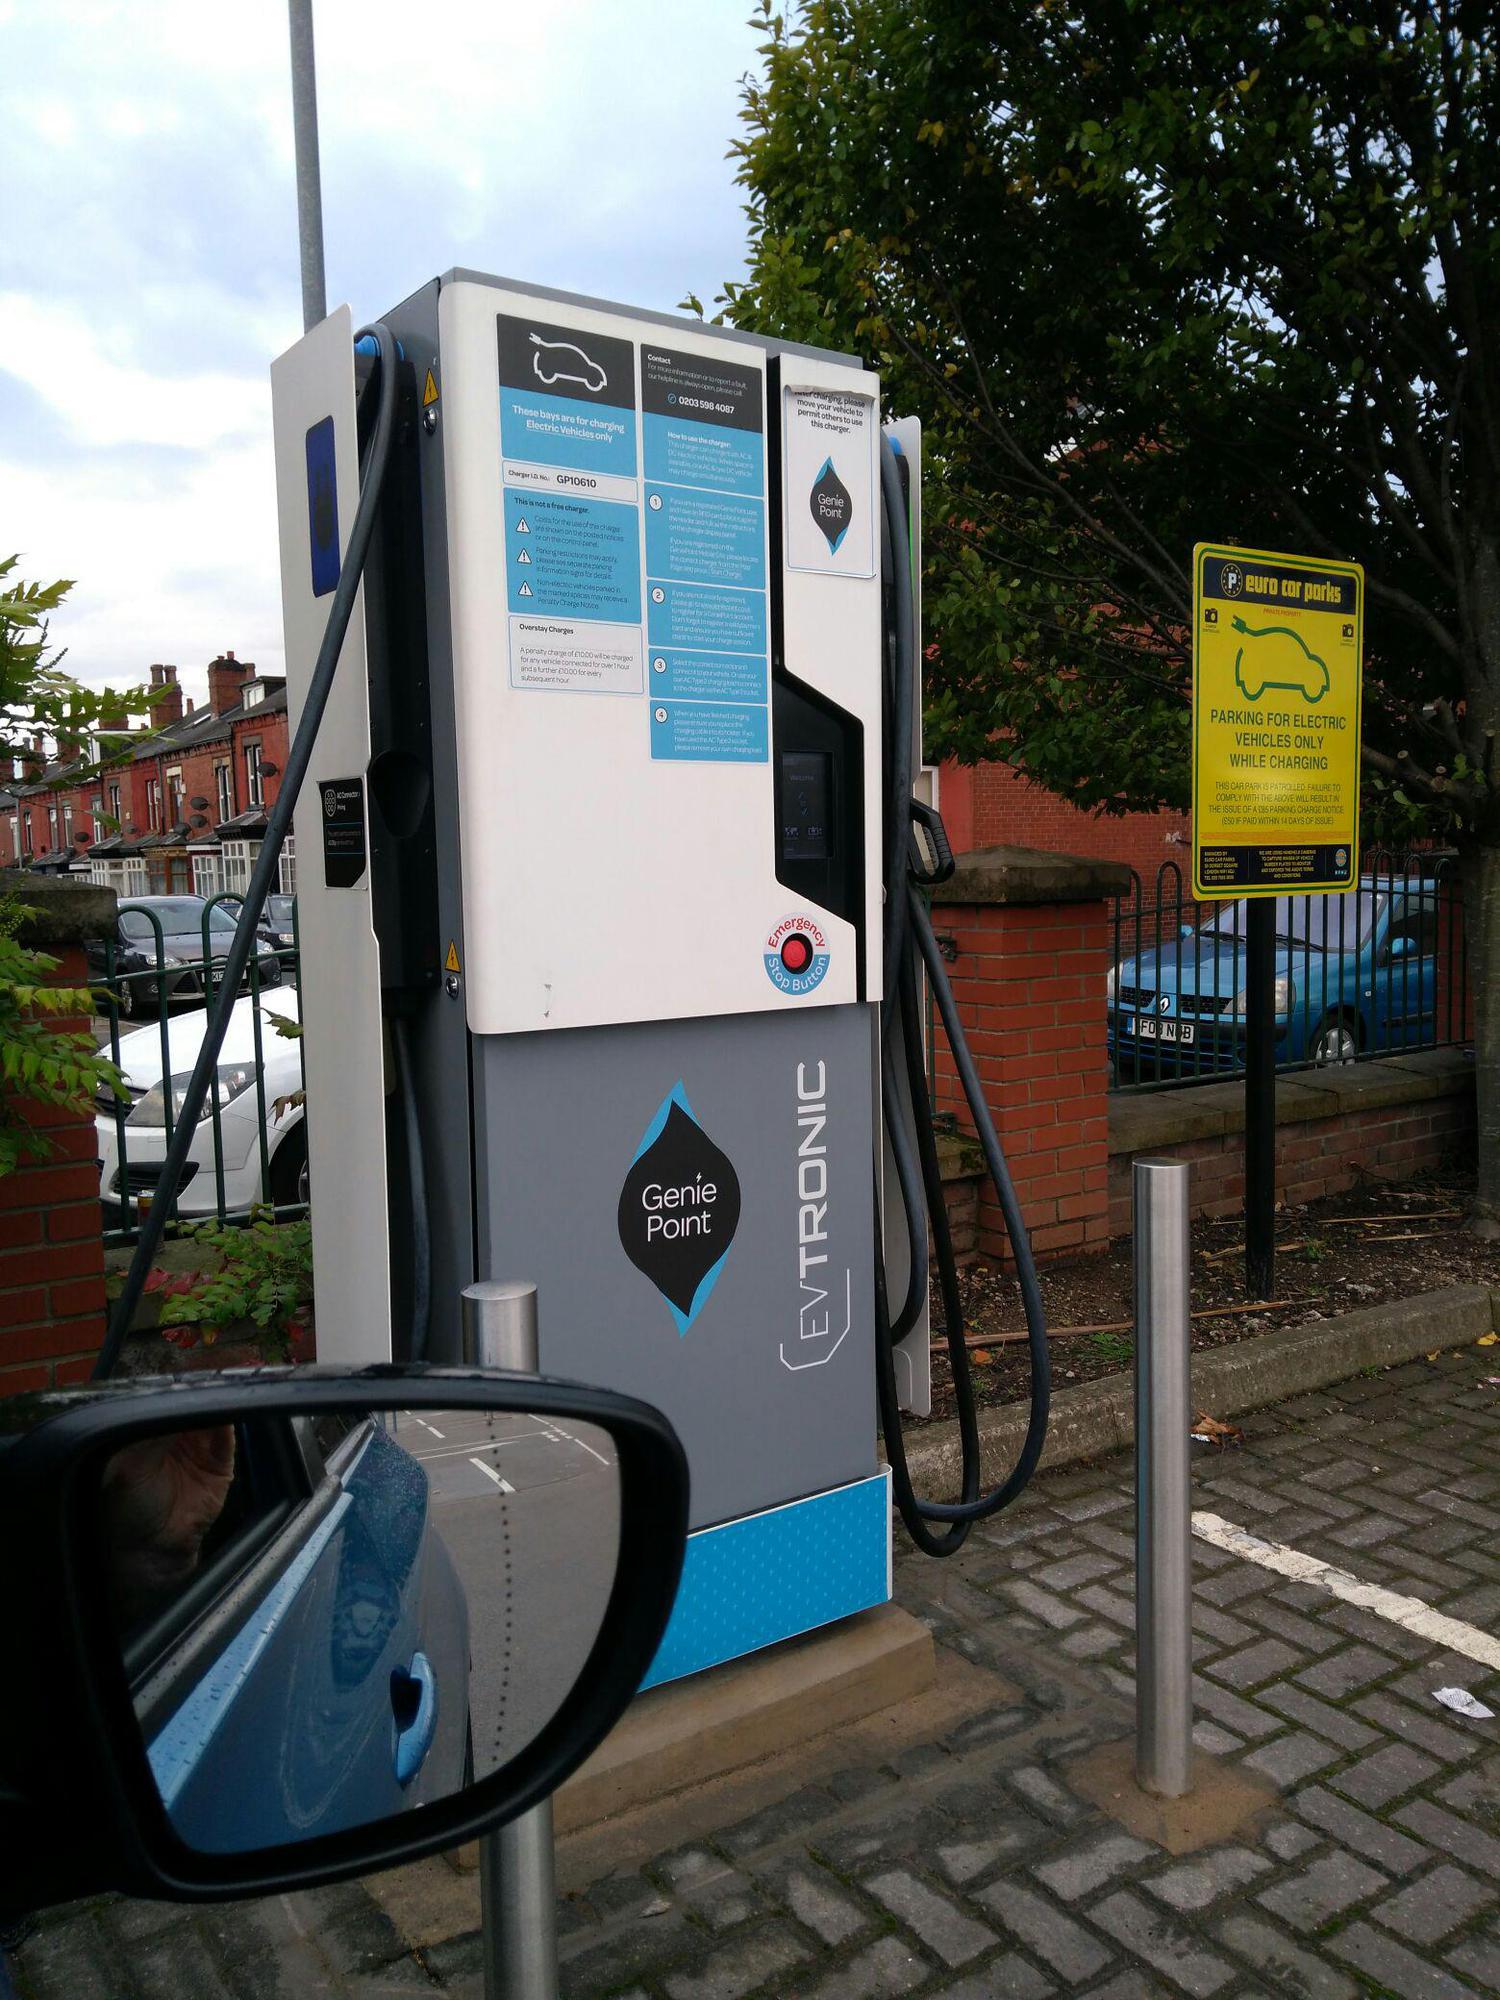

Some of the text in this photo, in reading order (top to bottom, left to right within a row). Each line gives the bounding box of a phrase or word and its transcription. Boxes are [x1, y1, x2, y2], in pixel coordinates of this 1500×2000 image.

[648, 354, 671, 365] Contact
[679, 396, 735, 414] 0203 598 4087
[797, 400, 816, 409] move
[817, 403, 831, 412] your
[833, 405, 855, 415] vehicle
[844, 398, 865, 407] please
[512, 405, 625, 434] These bays are for charging
[798, 409, 820, 418] permit
[822, 413, 843, 422] others
[527, 420, 612, 444] Electric Vehicles only
[811, 420, 850, 434] this charger.
[509, 470, 530, 479] Charger
[556, 475, 597, 488] GP10610
[818, 493, 844, 507] Genie
[820, 505, 842, 518] Point
[1246, 575, 1278, 595] euro
[1282, 580, 1302, 598] car
[1305, 579, 1341, 605] parks
[519, 624, 574, 635] Overstay Charges
[562, 660, 592, 668] connected
[611, 654, 633, 663] charged
[1211, 710, 1346, 730] PARKING FOR ELECTRIC
[1235, 732, 1324, 749] VEHICLES ONLY
[1230, 754, 1328, 770] WHILE CHARGING
[1216, 782, 1229, 790] THIS
[1231, 782, 1245, 790] CAR
[1263, 783, 1268, 791] IS
[1308, 784, 1332, 792] FAILURE
[1244, 794, 1259, 802] WITH
[1209, 805, 1222, 813] THE
[1270, 806, 1296, 814] PARKING
[1243, 817, 1256, 825] PAID
[1257, 817, 1280, 825] WITHIN
[768, 918, 825, 948] Emergency
[769, 958, 826, 990] Stop Button
[642, 1172, 717, 1211] Genie
[797, 1060, 828, 1339] EVTRONIC
[647, 1211, 712, 1242] Point
